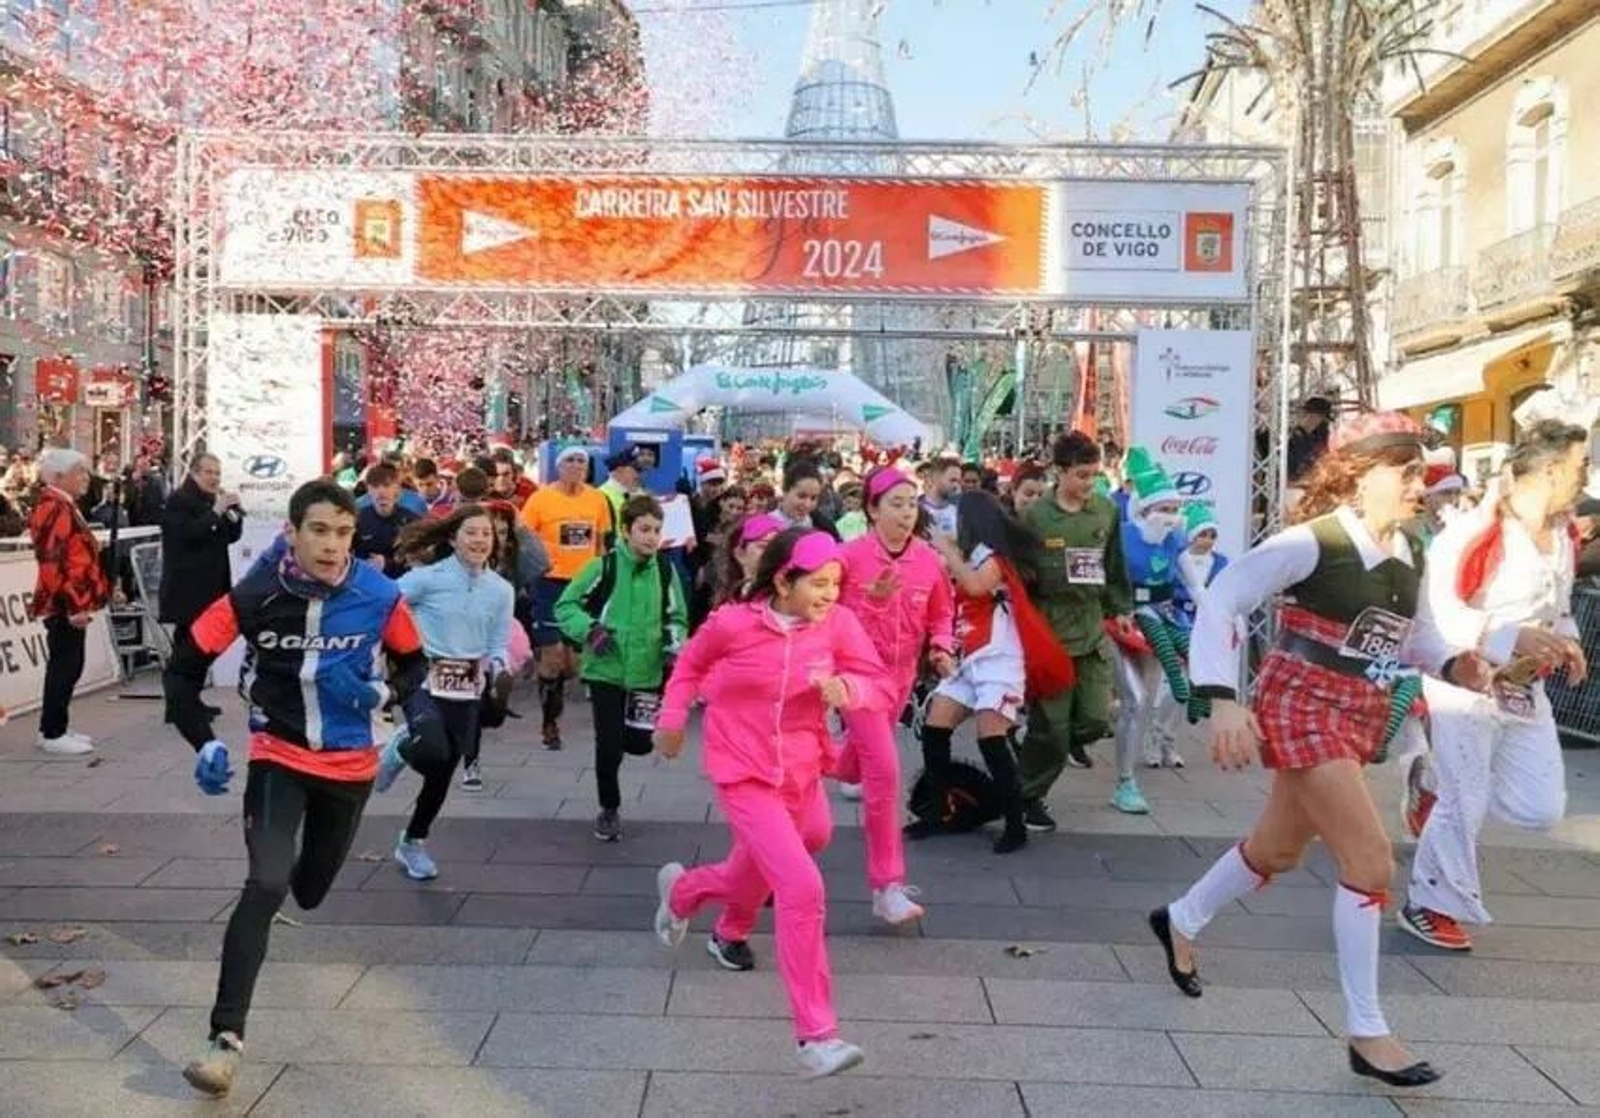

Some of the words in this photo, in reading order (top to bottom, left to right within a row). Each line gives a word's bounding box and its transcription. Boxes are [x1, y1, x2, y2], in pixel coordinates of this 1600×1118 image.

[575, 187, 682, 218] CARREIRA
[685, 187, 731, 219] SAN
[736, 187, 850, 219] SILVESTRE
[1070, 222, 1171, 239] CONCELLO
[802, 239, 884, 279] 2024
[1083, 241, 1107, 256] DE
[1113, 241, 1160, 257] VIGO
[279, 634, 368, 650] GIANT
[0, 641, 20, 674] E
